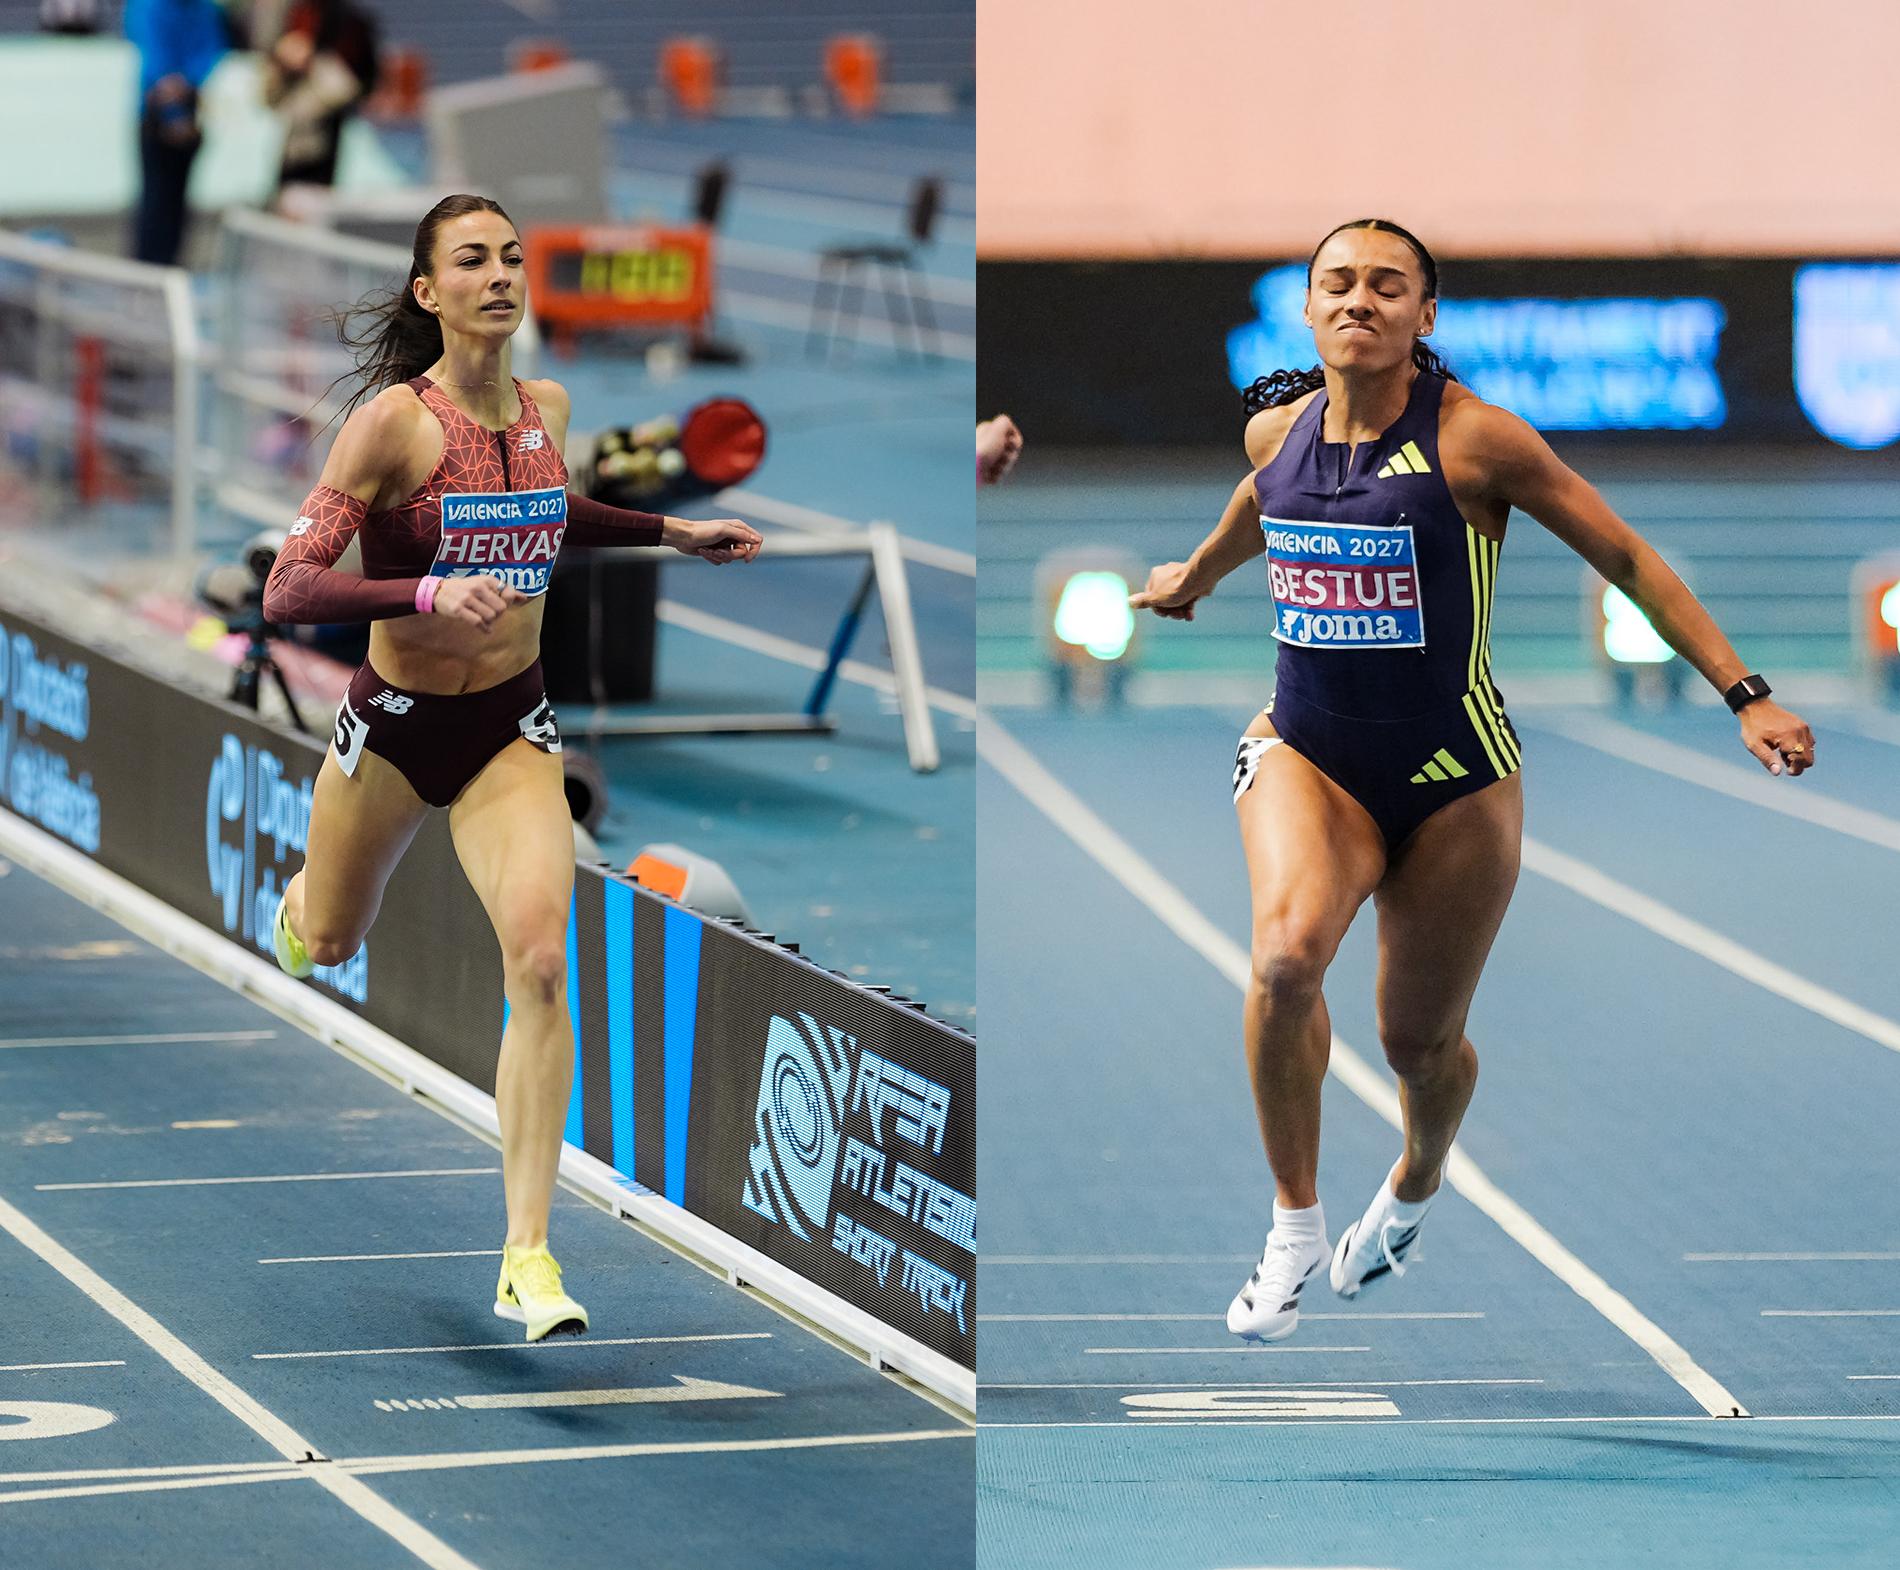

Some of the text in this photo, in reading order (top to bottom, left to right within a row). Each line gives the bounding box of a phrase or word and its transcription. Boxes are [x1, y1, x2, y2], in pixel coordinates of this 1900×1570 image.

[448, 497, 563, 521] VALENCIA 2027
[438, 527, 564, 564] HERVAS
[1264, 529, 1404, 558] VALENCIA 2027
[478, 567, 548, 590] oma
[1270, 562, 1414, 608] BESTUE
[831, 1211, 968, 1336] SHORT TRACK
